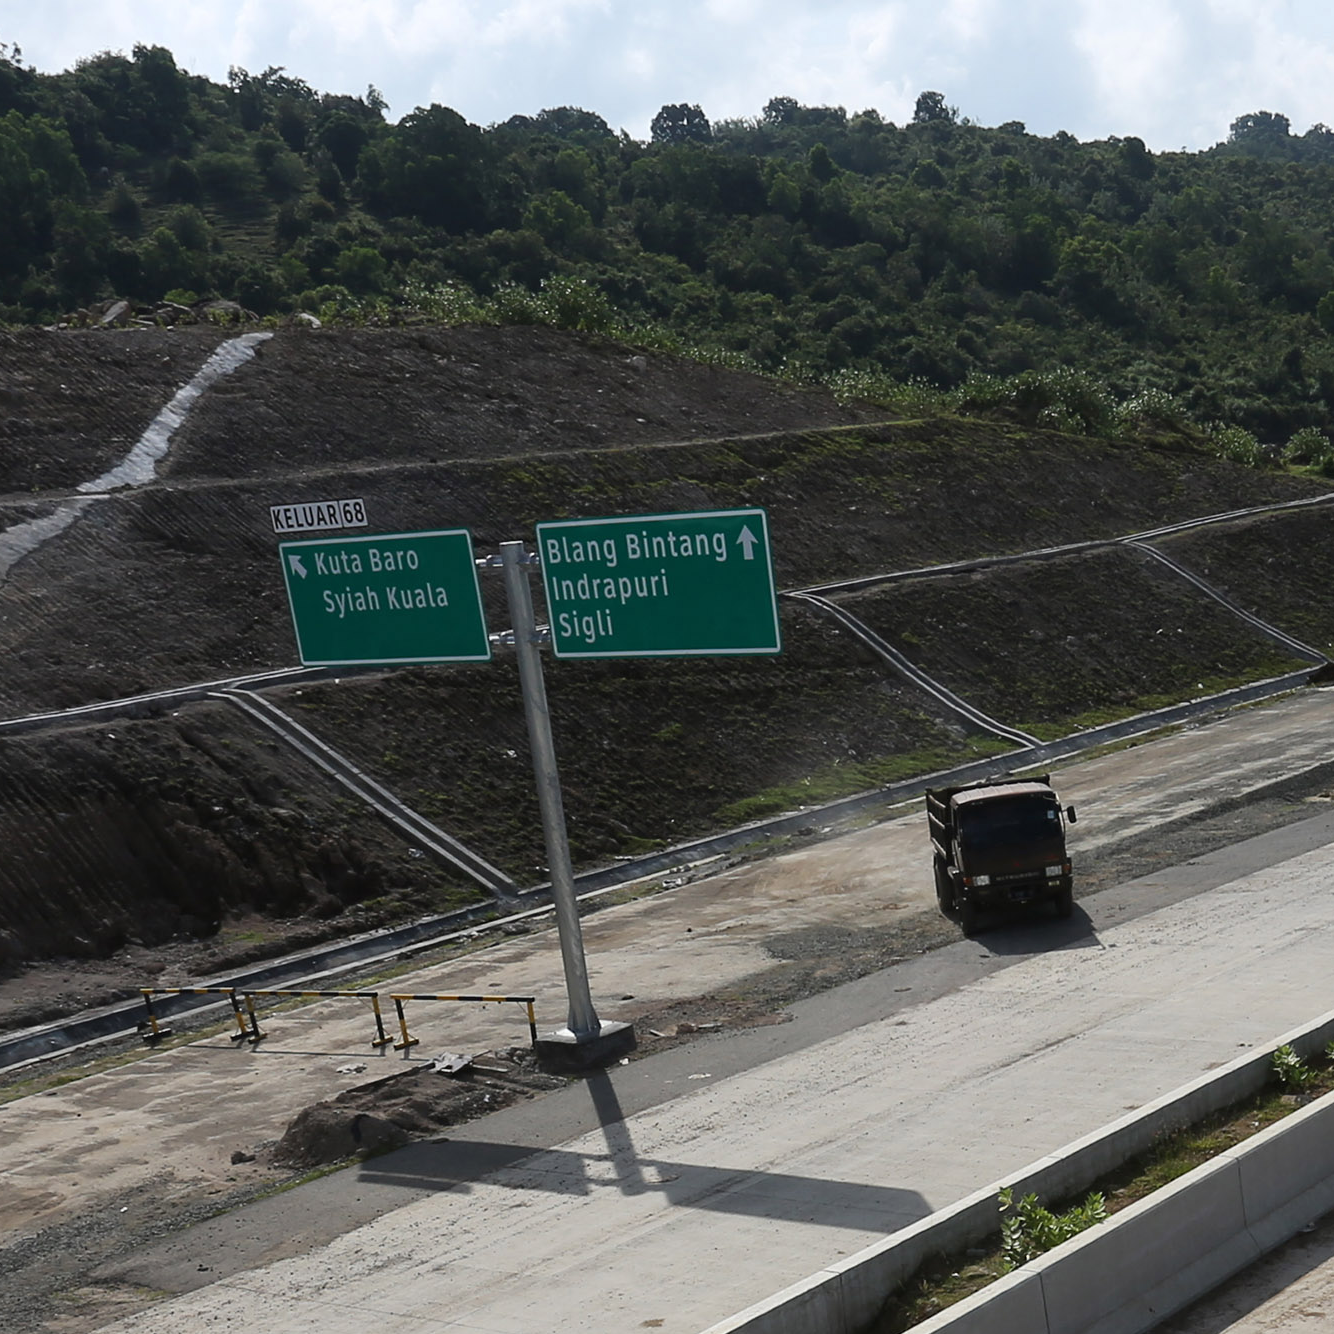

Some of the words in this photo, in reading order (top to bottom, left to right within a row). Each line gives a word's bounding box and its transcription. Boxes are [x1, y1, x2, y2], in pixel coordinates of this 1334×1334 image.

[272, 504, 339, 530] KELUAR
[342, 501, 365, 523] 68
[314, 550, 363, 575] Kuta
[368, 548, 419, 572] Baro
[546, 536, 618, 567] Blang
[625, 530, 727, 562] Bintang
[322, 585, 380, 618] Syiah
[386, 582, 449, 610] Kuala
[552, 568, 668, 605] Indrapuri
[559, 608, 613, 643] Sigli
